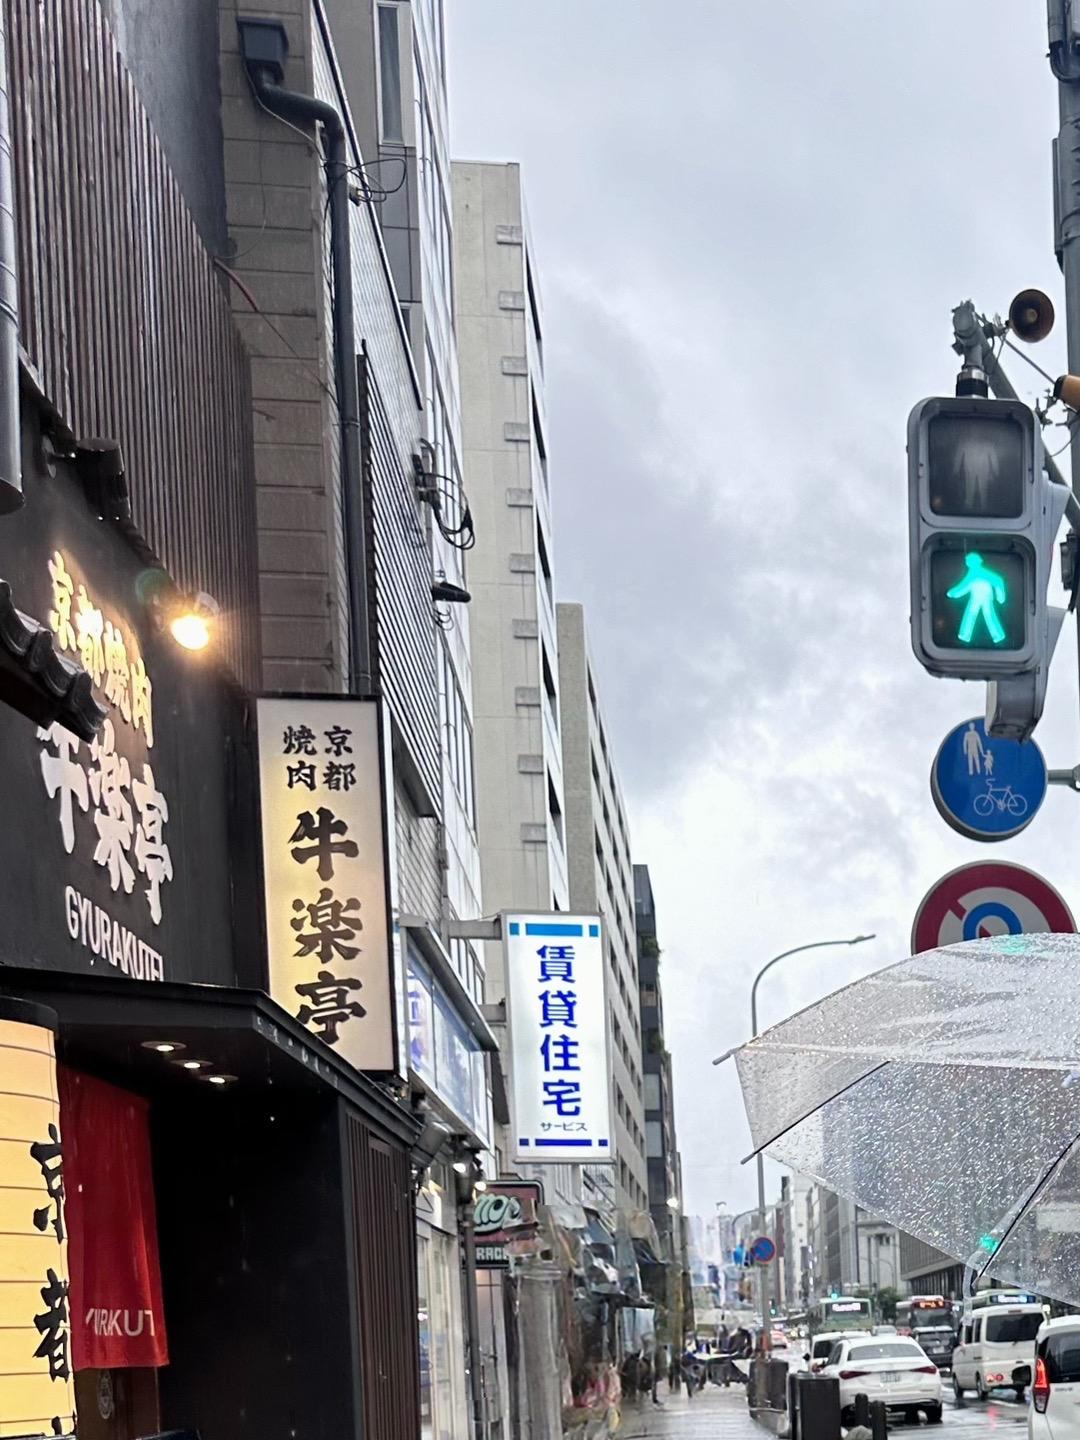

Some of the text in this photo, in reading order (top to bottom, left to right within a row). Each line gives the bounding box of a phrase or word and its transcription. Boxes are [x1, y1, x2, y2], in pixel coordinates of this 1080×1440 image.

[288, 806, 368, 1046] 牛楽亭
[536, 944, 582, 1117] 賃貸住宅
[540, 1121, 588, 1132] サービス
